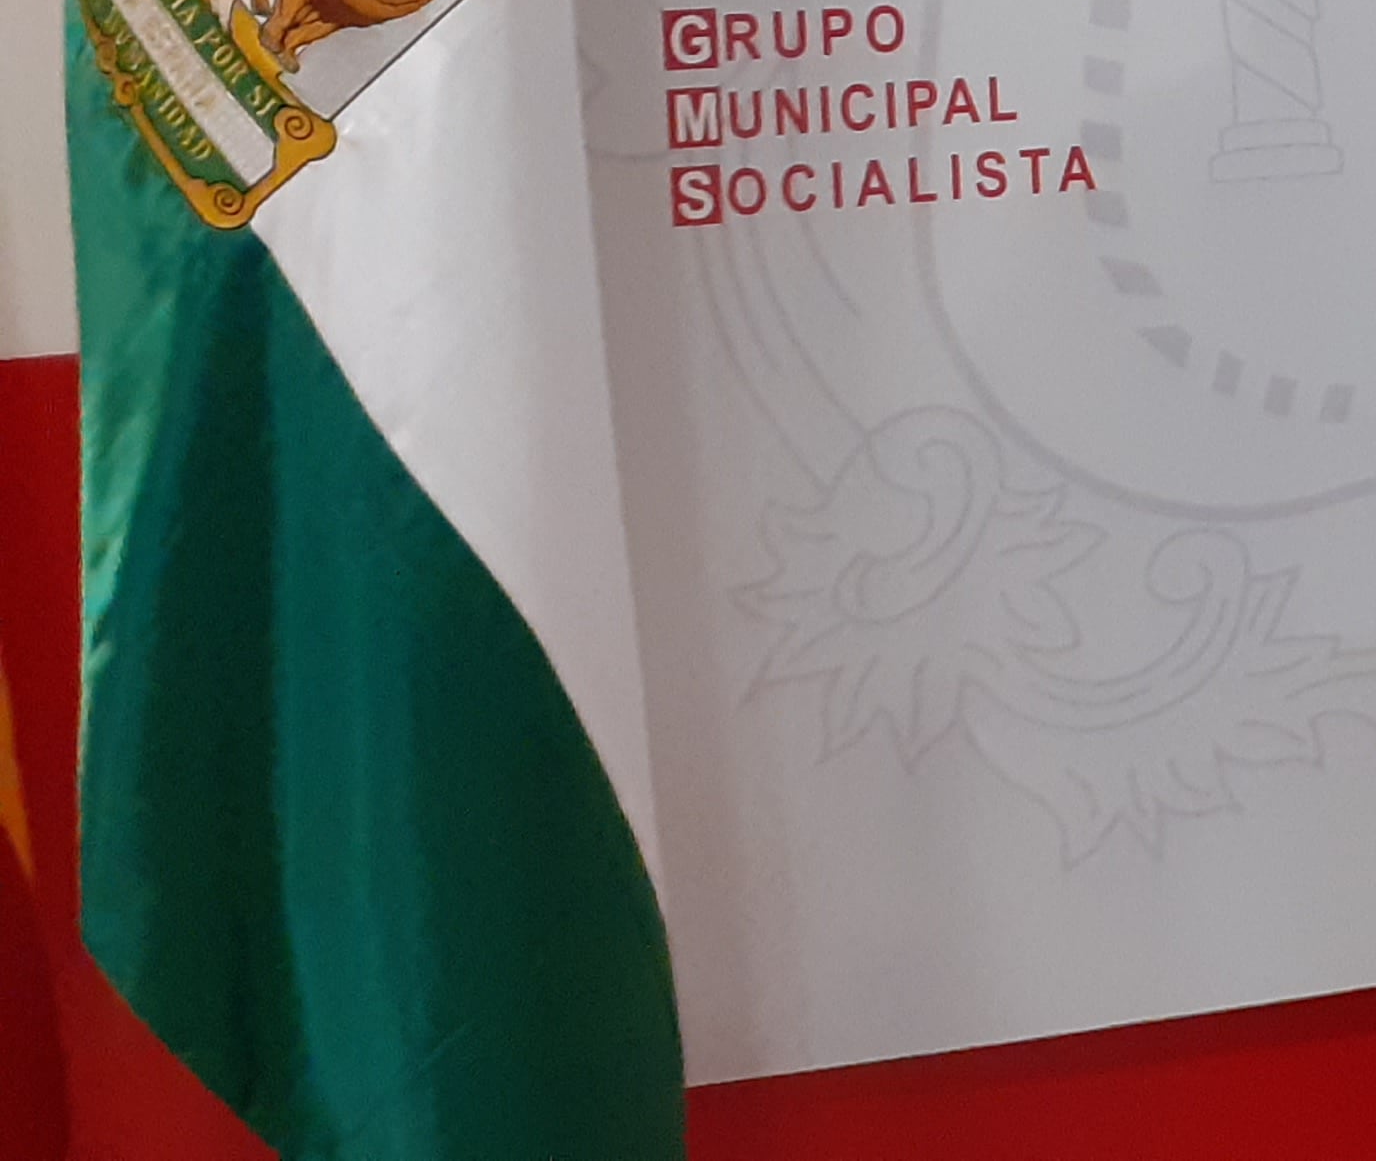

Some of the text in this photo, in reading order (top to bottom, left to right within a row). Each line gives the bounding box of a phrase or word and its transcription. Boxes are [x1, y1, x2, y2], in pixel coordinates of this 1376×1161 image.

[663, 4, 906, 70] GRUPO
[668, 76, 1019, 150] MUNICIPAL
[671, 145, 1097, 227] SOCIALISTA
